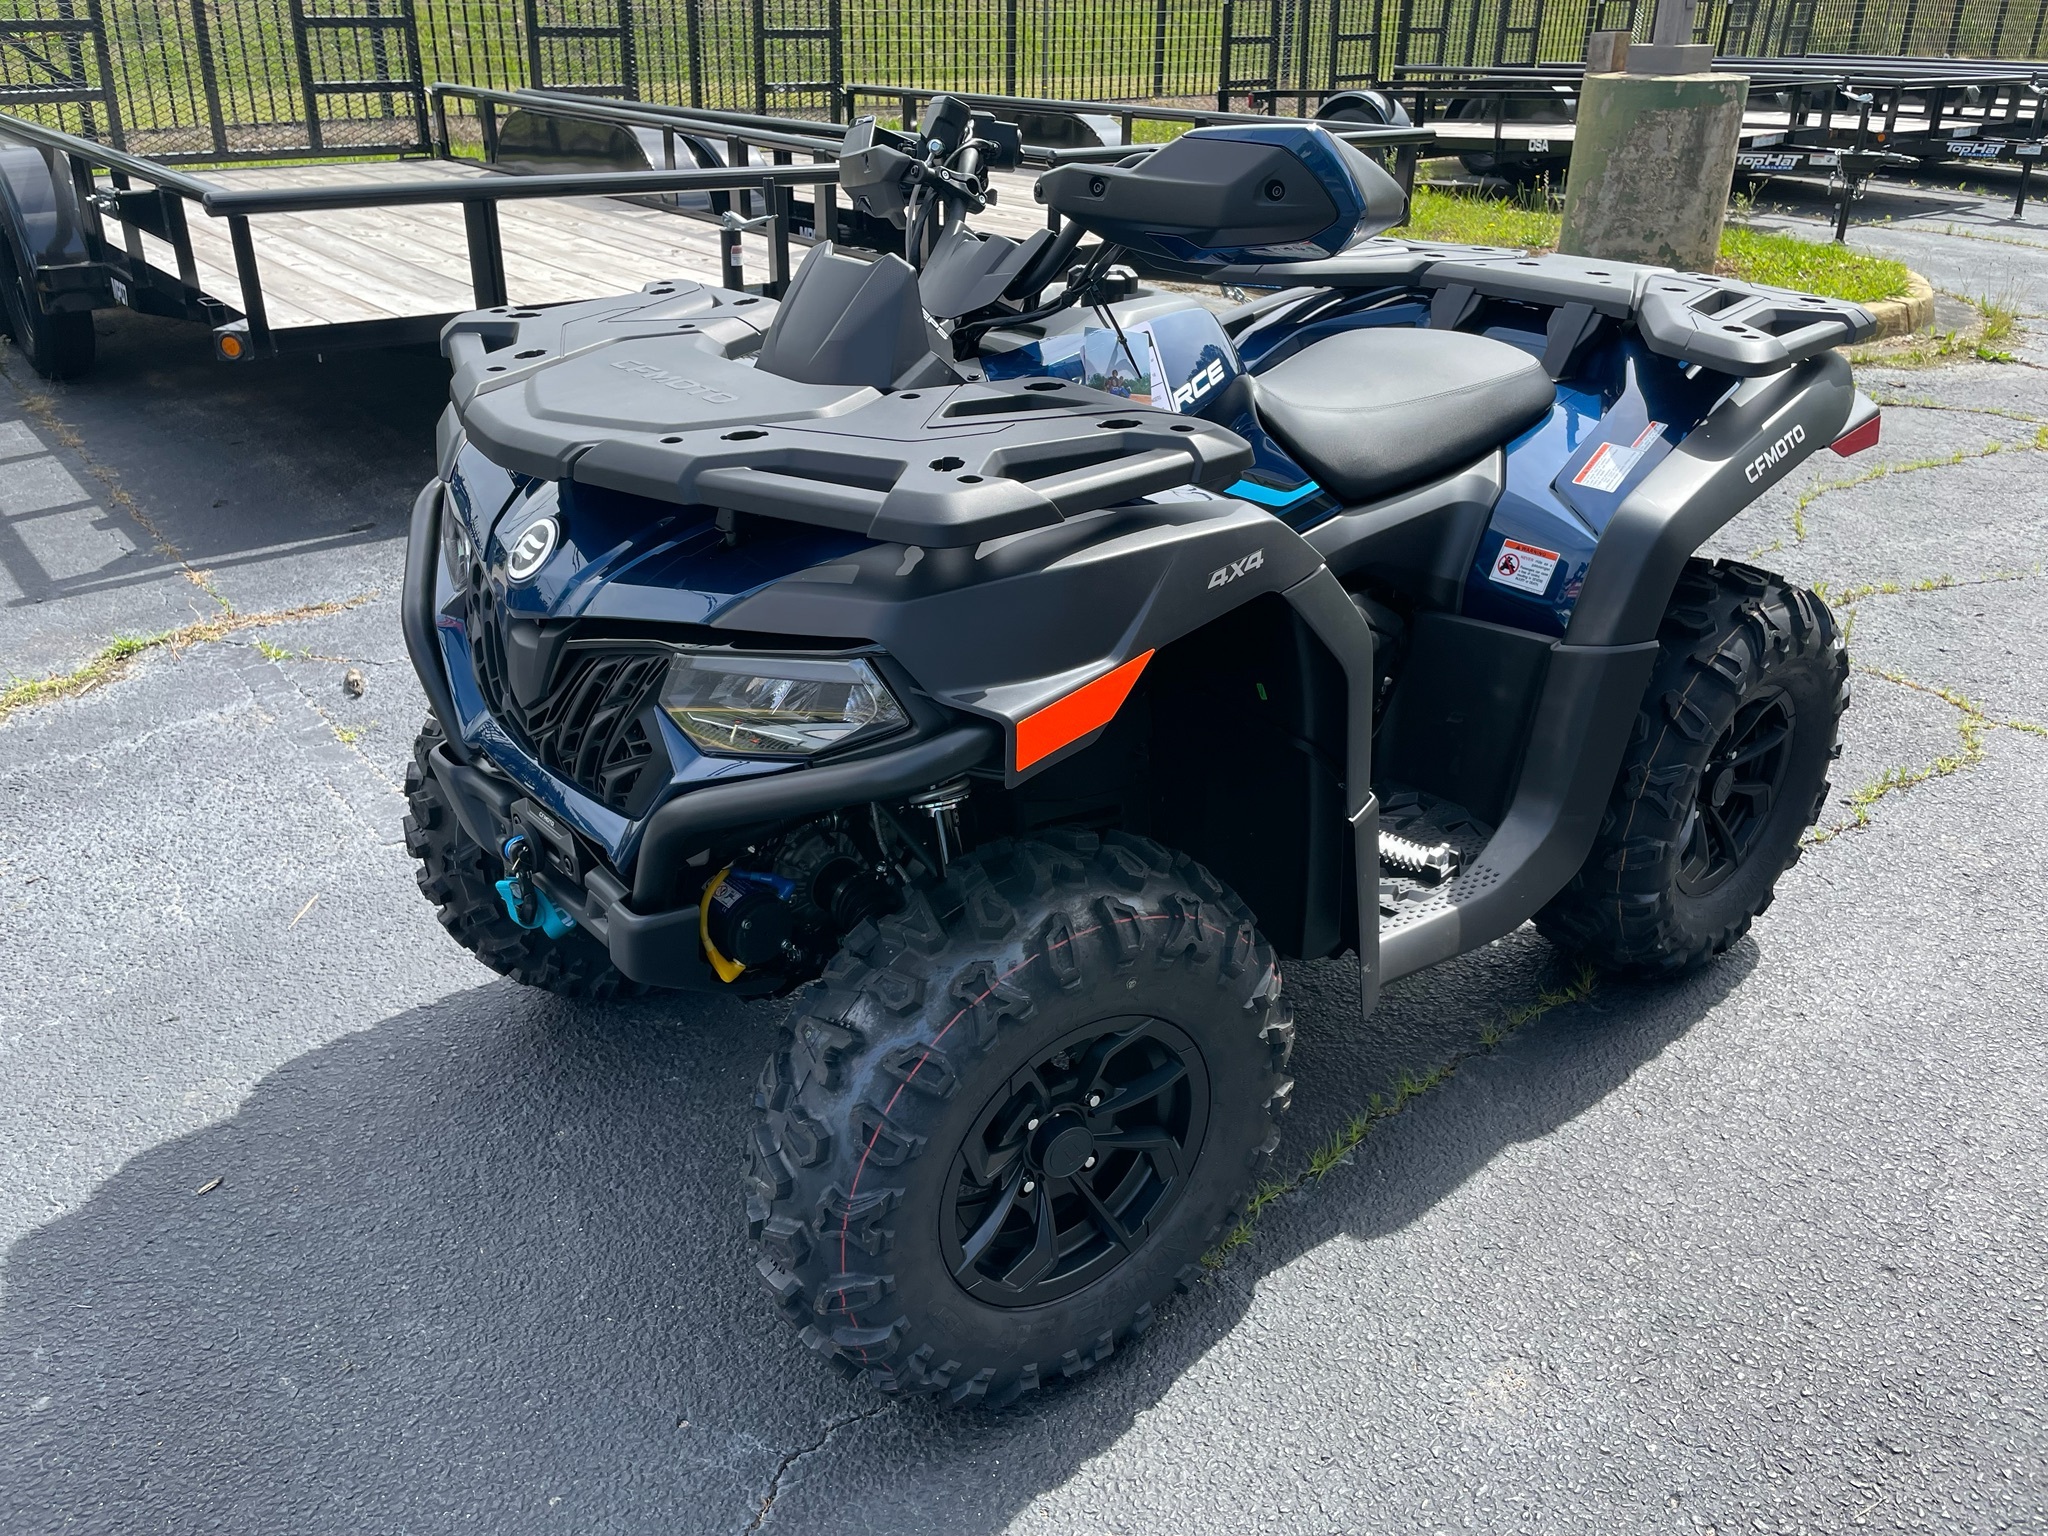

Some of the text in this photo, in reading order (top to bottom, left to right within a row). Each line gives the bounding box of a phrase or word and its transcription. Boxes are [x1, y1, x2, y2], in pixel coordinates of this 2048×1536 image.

[921, 307, 949, 340] EPS
[610, 360, 739, 404] CFMOTO
[1744, 424, 1806, 484] CFMOTO
[538, 811, 555, 827] CFMOTO
